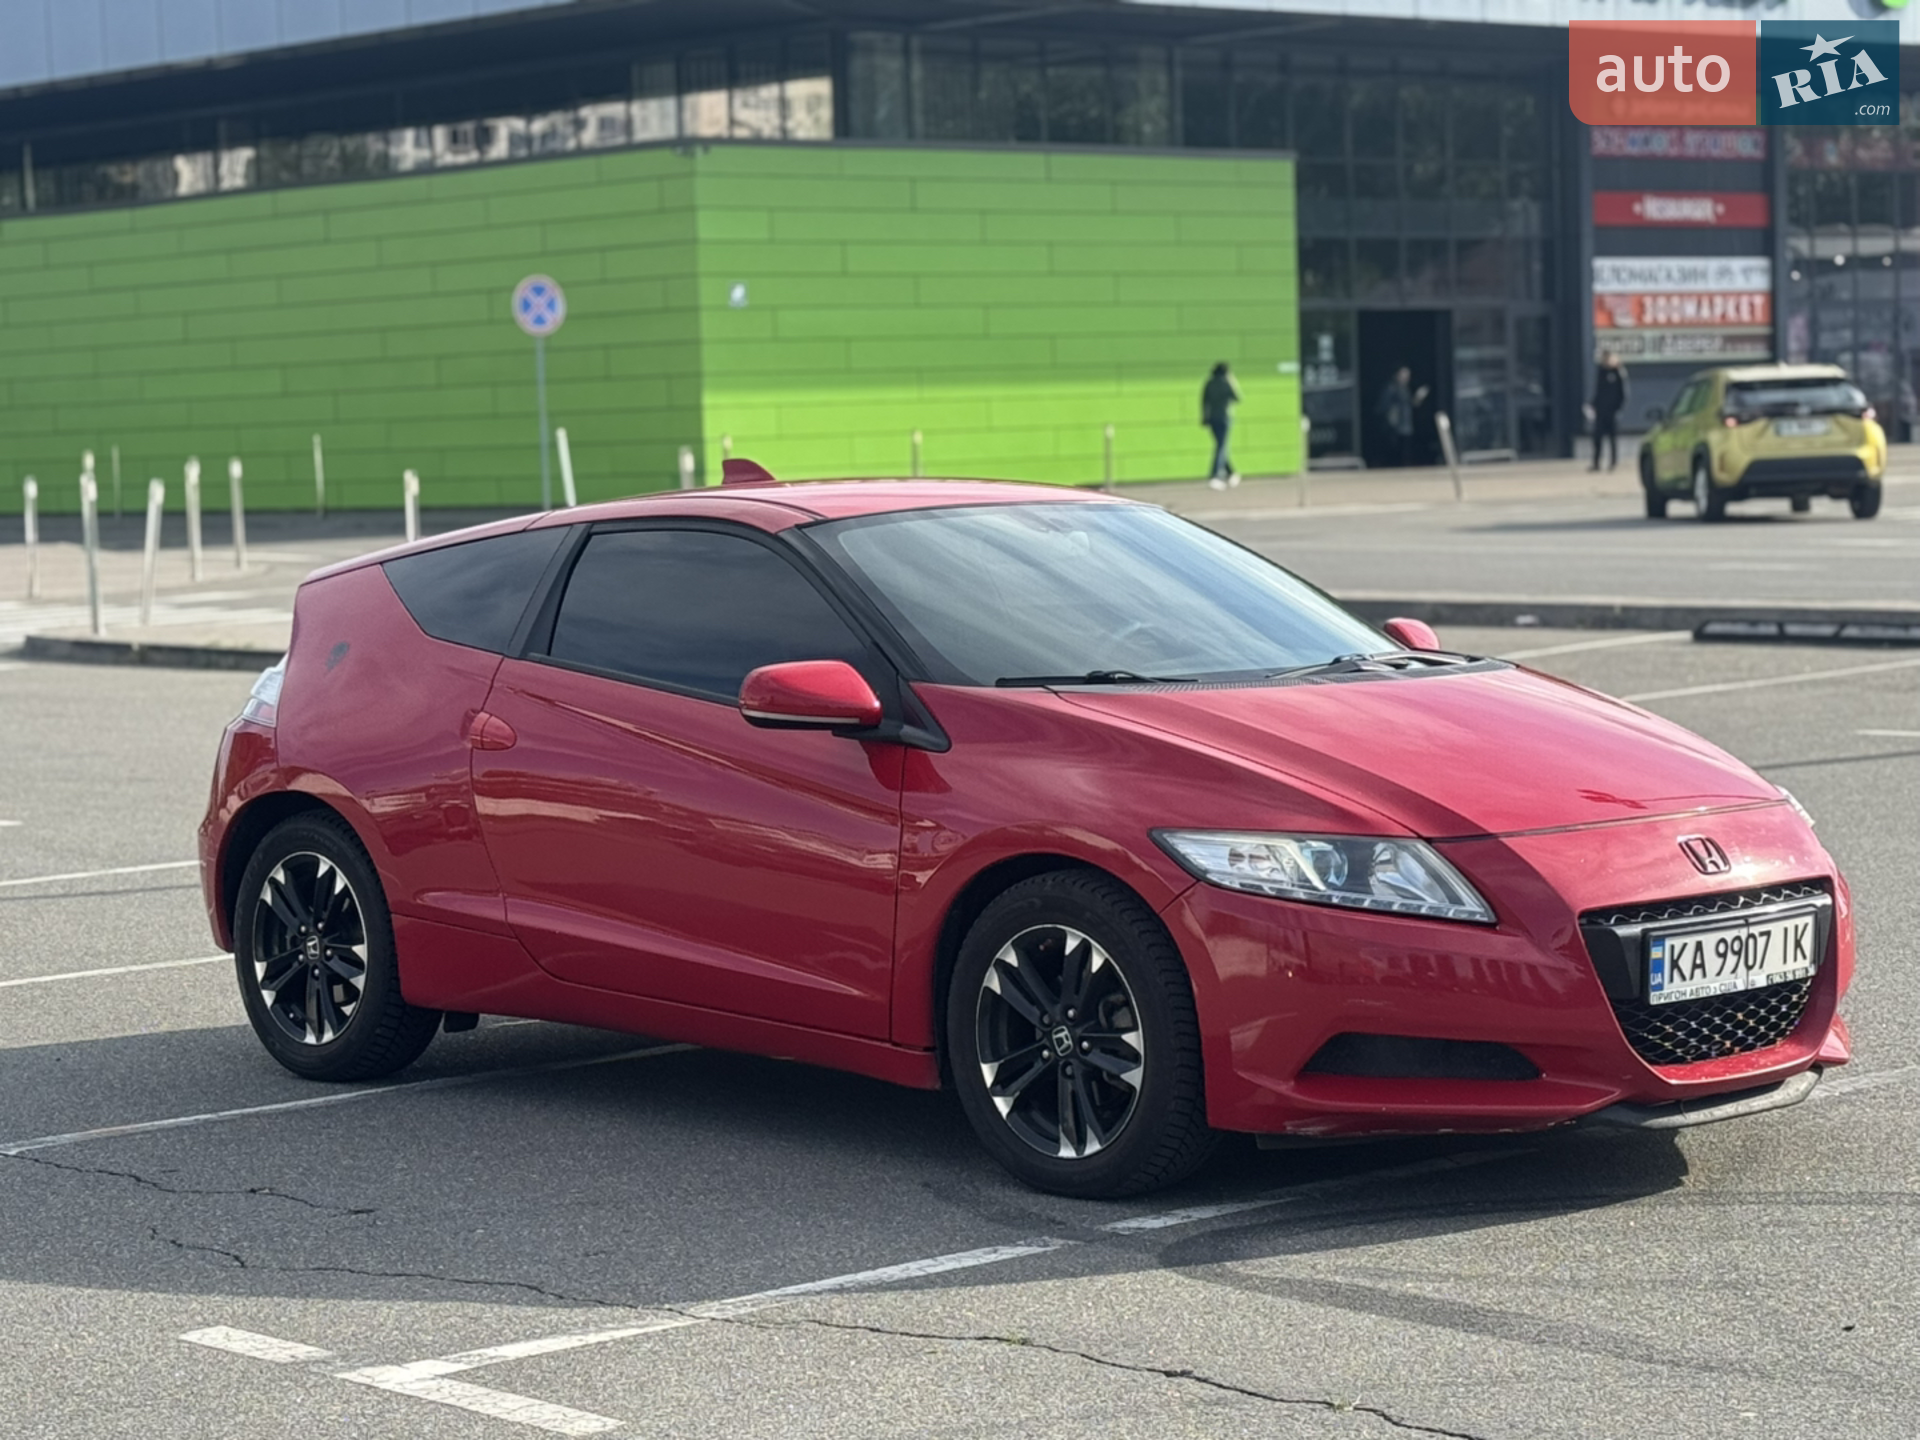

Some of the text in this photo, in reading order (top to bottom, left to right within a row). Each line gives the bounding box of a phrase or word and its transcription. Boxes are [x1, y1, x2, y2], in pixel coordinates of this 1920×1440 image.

[1642, 294, 1767, 324] ЗООМАРКЕТ
[1669, 940, 1707, 983] KA
[1715, 930, 1771, 977] 9907
[1783, 922, 1809, 965] IK
[1650, 972, 1663, 985] UA
[1651, 989, 1688, 1003] ПРИГОН
[1688, 985, 1712, 998] АВТО
[1718, 981, 1738, 993] США
